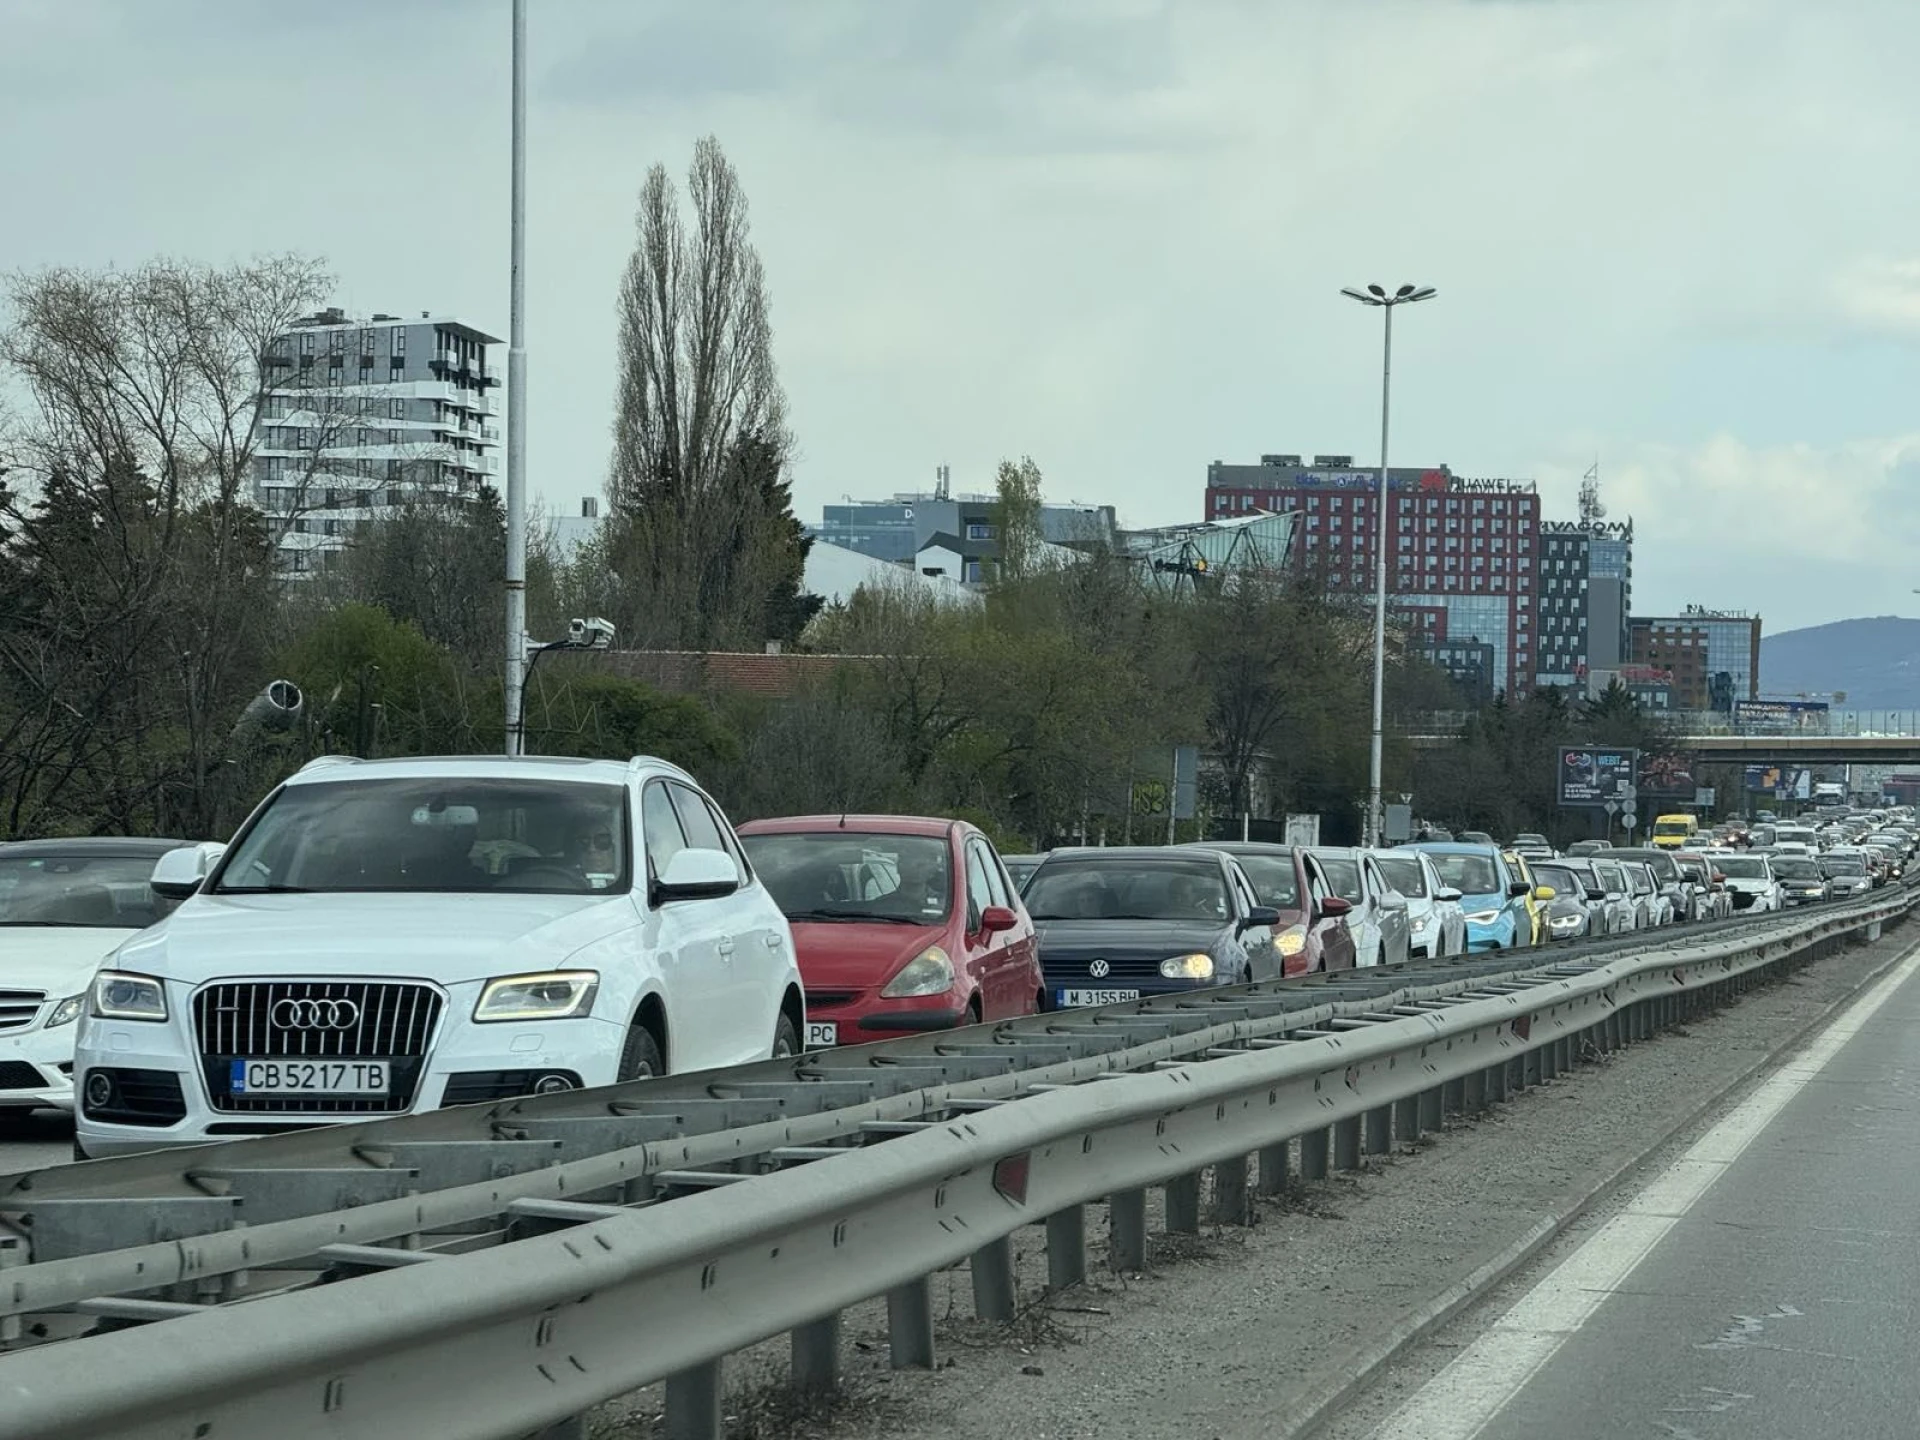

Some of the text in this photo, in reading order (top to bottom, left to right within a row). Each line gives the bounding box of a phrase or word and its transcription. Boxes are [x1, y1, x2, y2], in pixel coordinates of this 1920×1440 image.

[1451, 478, 1511, 490] HUAWEI
[1085, 991, 1117, 1004] 3155
[811, 1025, 833, 1042] PC
[286, 1064, 346, 1089] 5217
